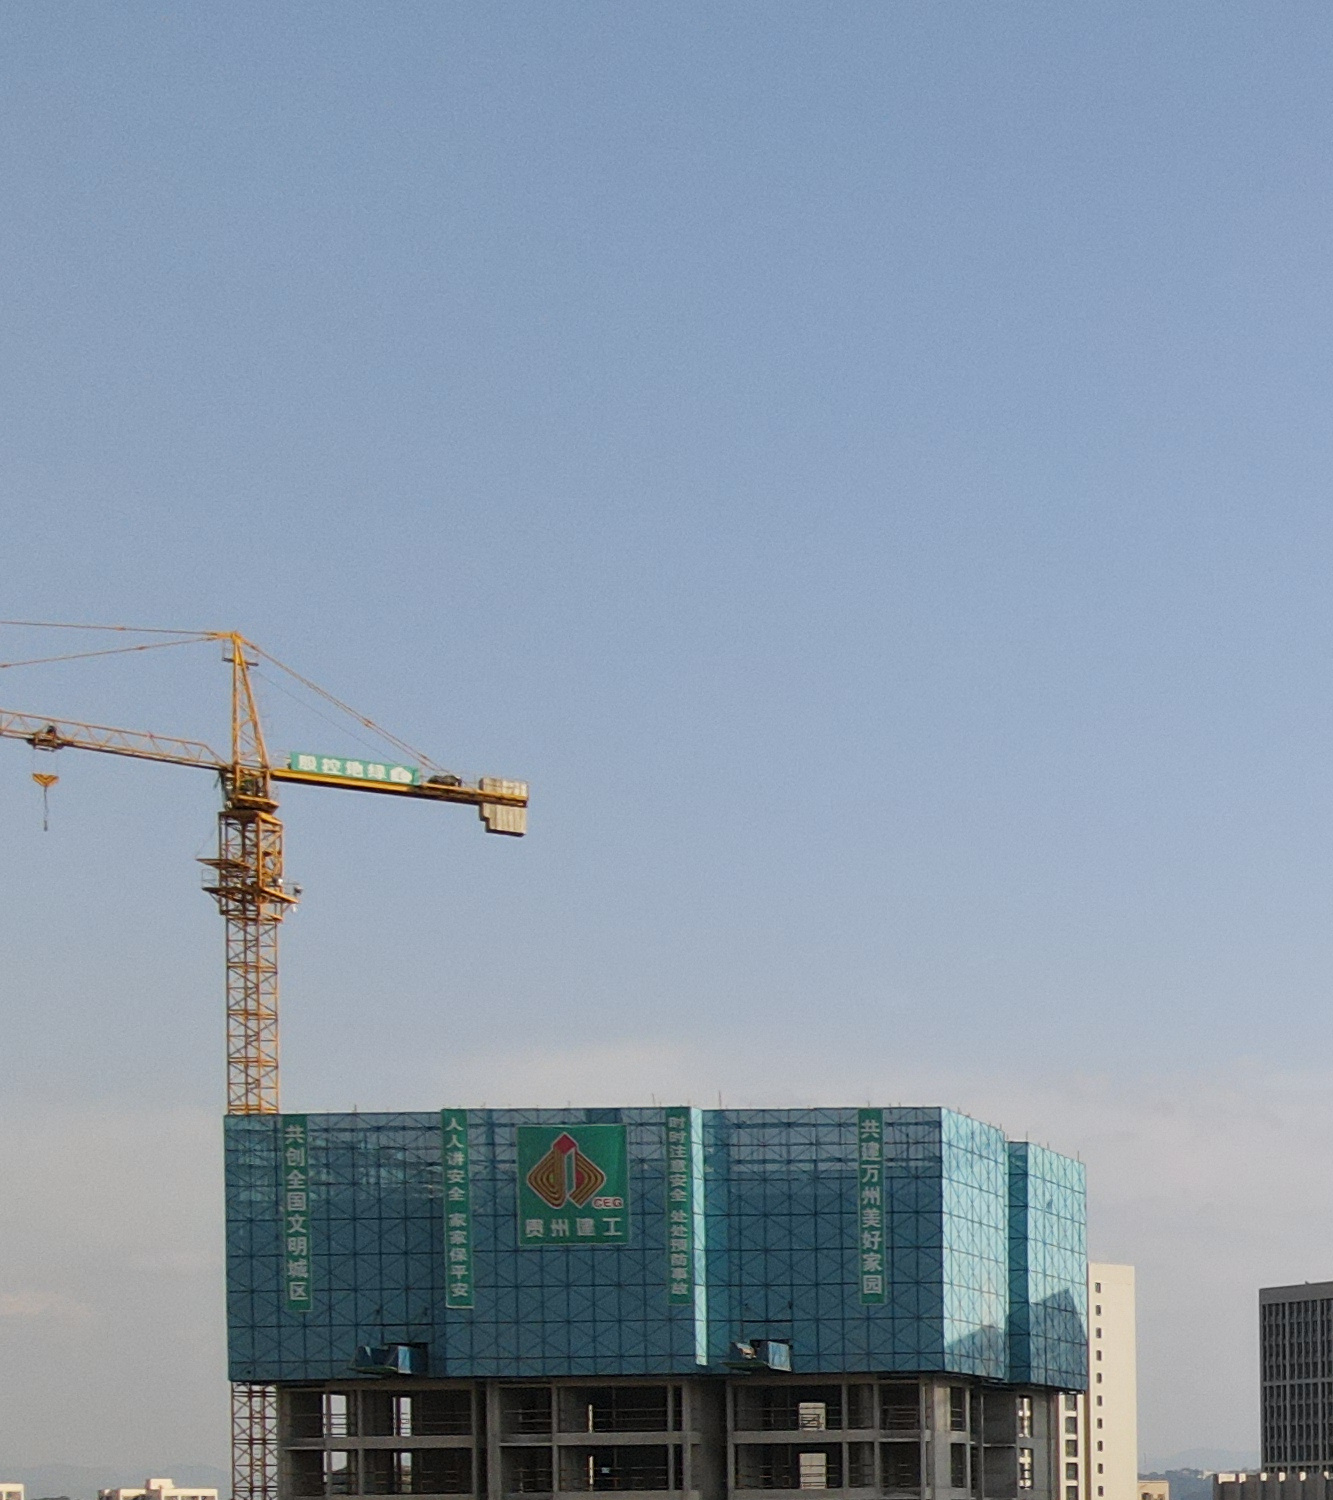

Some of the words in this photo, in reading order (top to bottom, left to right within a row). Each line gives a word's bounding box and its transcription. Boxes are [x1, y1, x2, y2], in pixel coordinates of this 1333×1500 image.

[445, 1116, 467, 1202] 人人讲安全
[285, 1123, 309, 1301] 共创全国文明城区
[525, 1217, 622, 1238] 贵州建工
[861, 1118, 883, 1295] 共建万州美好家园
[449, 1212, 471, 1297] 家家保平安
